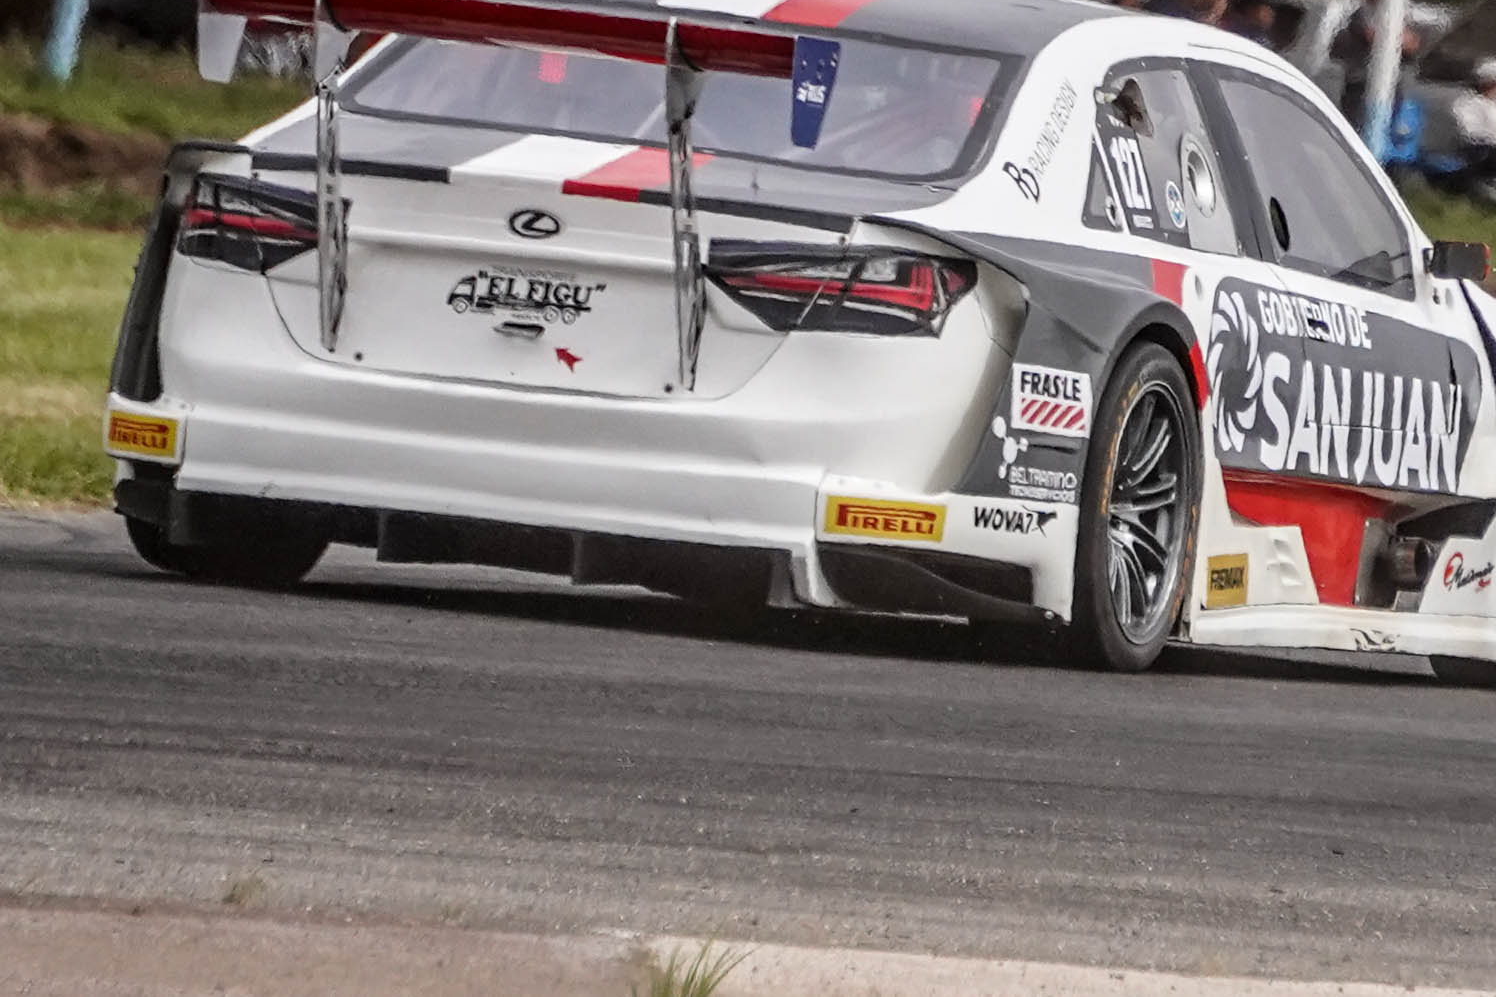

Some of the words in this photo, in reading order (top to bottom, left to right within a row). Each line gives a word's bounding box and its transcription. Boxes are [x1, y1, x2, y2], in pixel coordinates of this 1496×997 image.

[1348, 309, 1372, 349] DE
[1259, 352, 1350, 479] SAN
[1353, 370, 1462, 492] JUAN
[836, 504, 936, 535] PIRELLI
